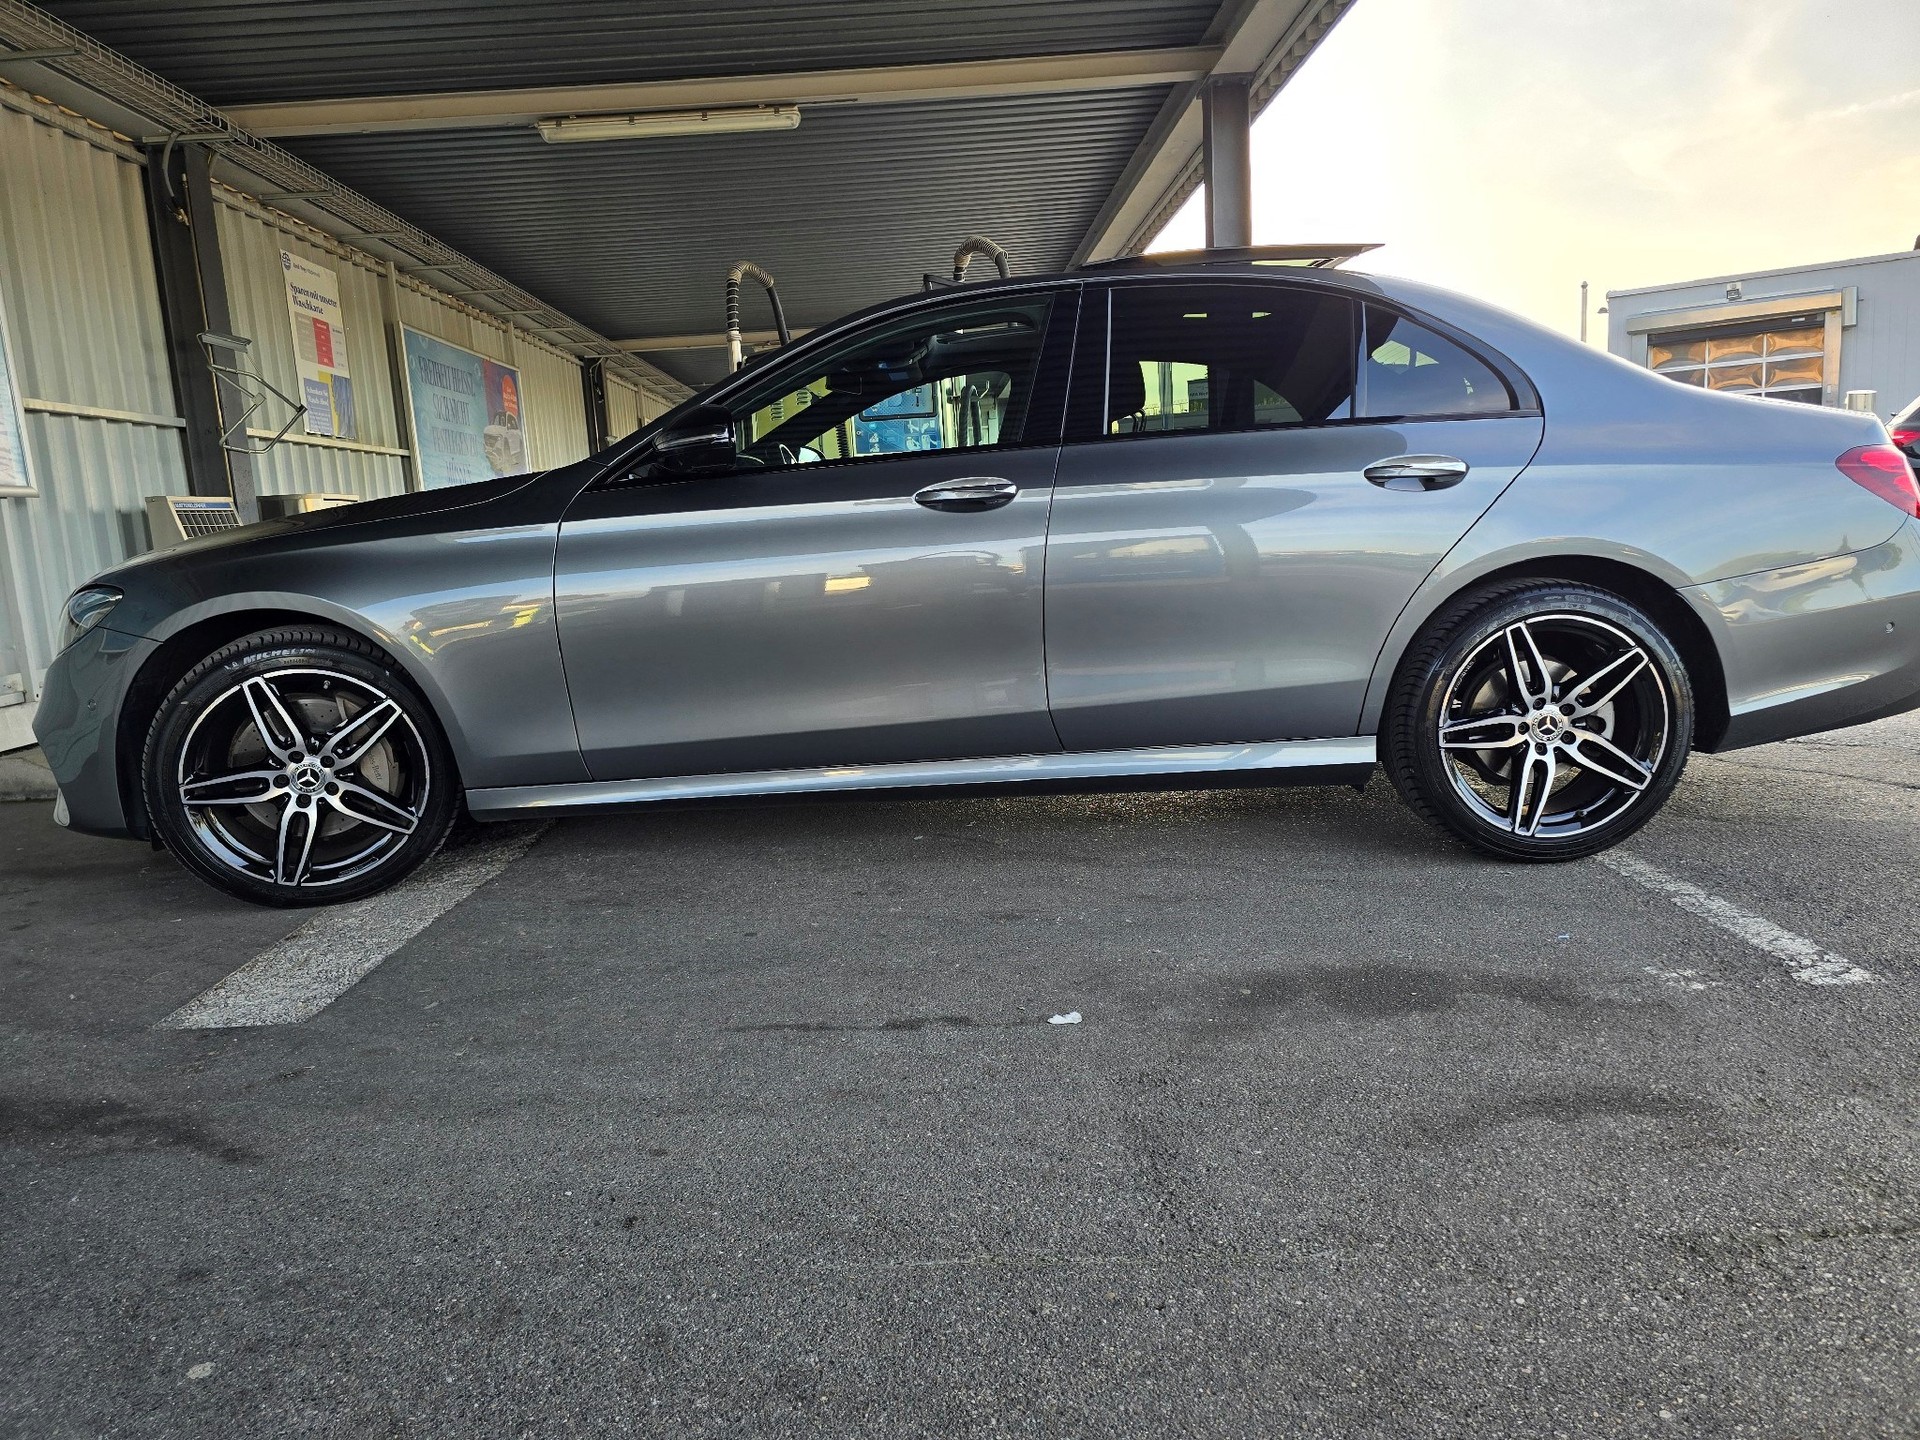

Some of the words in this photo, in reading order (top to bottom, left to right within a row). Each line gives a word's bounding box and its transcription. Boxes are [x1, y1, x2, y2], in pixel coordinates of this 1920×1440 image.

[289, 282, 309, 298] Sparen
[292, 295, 324, 315] Waschkarte
[418, 355, 452, 391] FREIHEIT
[243, 648, 316, 665] MICHELIN
